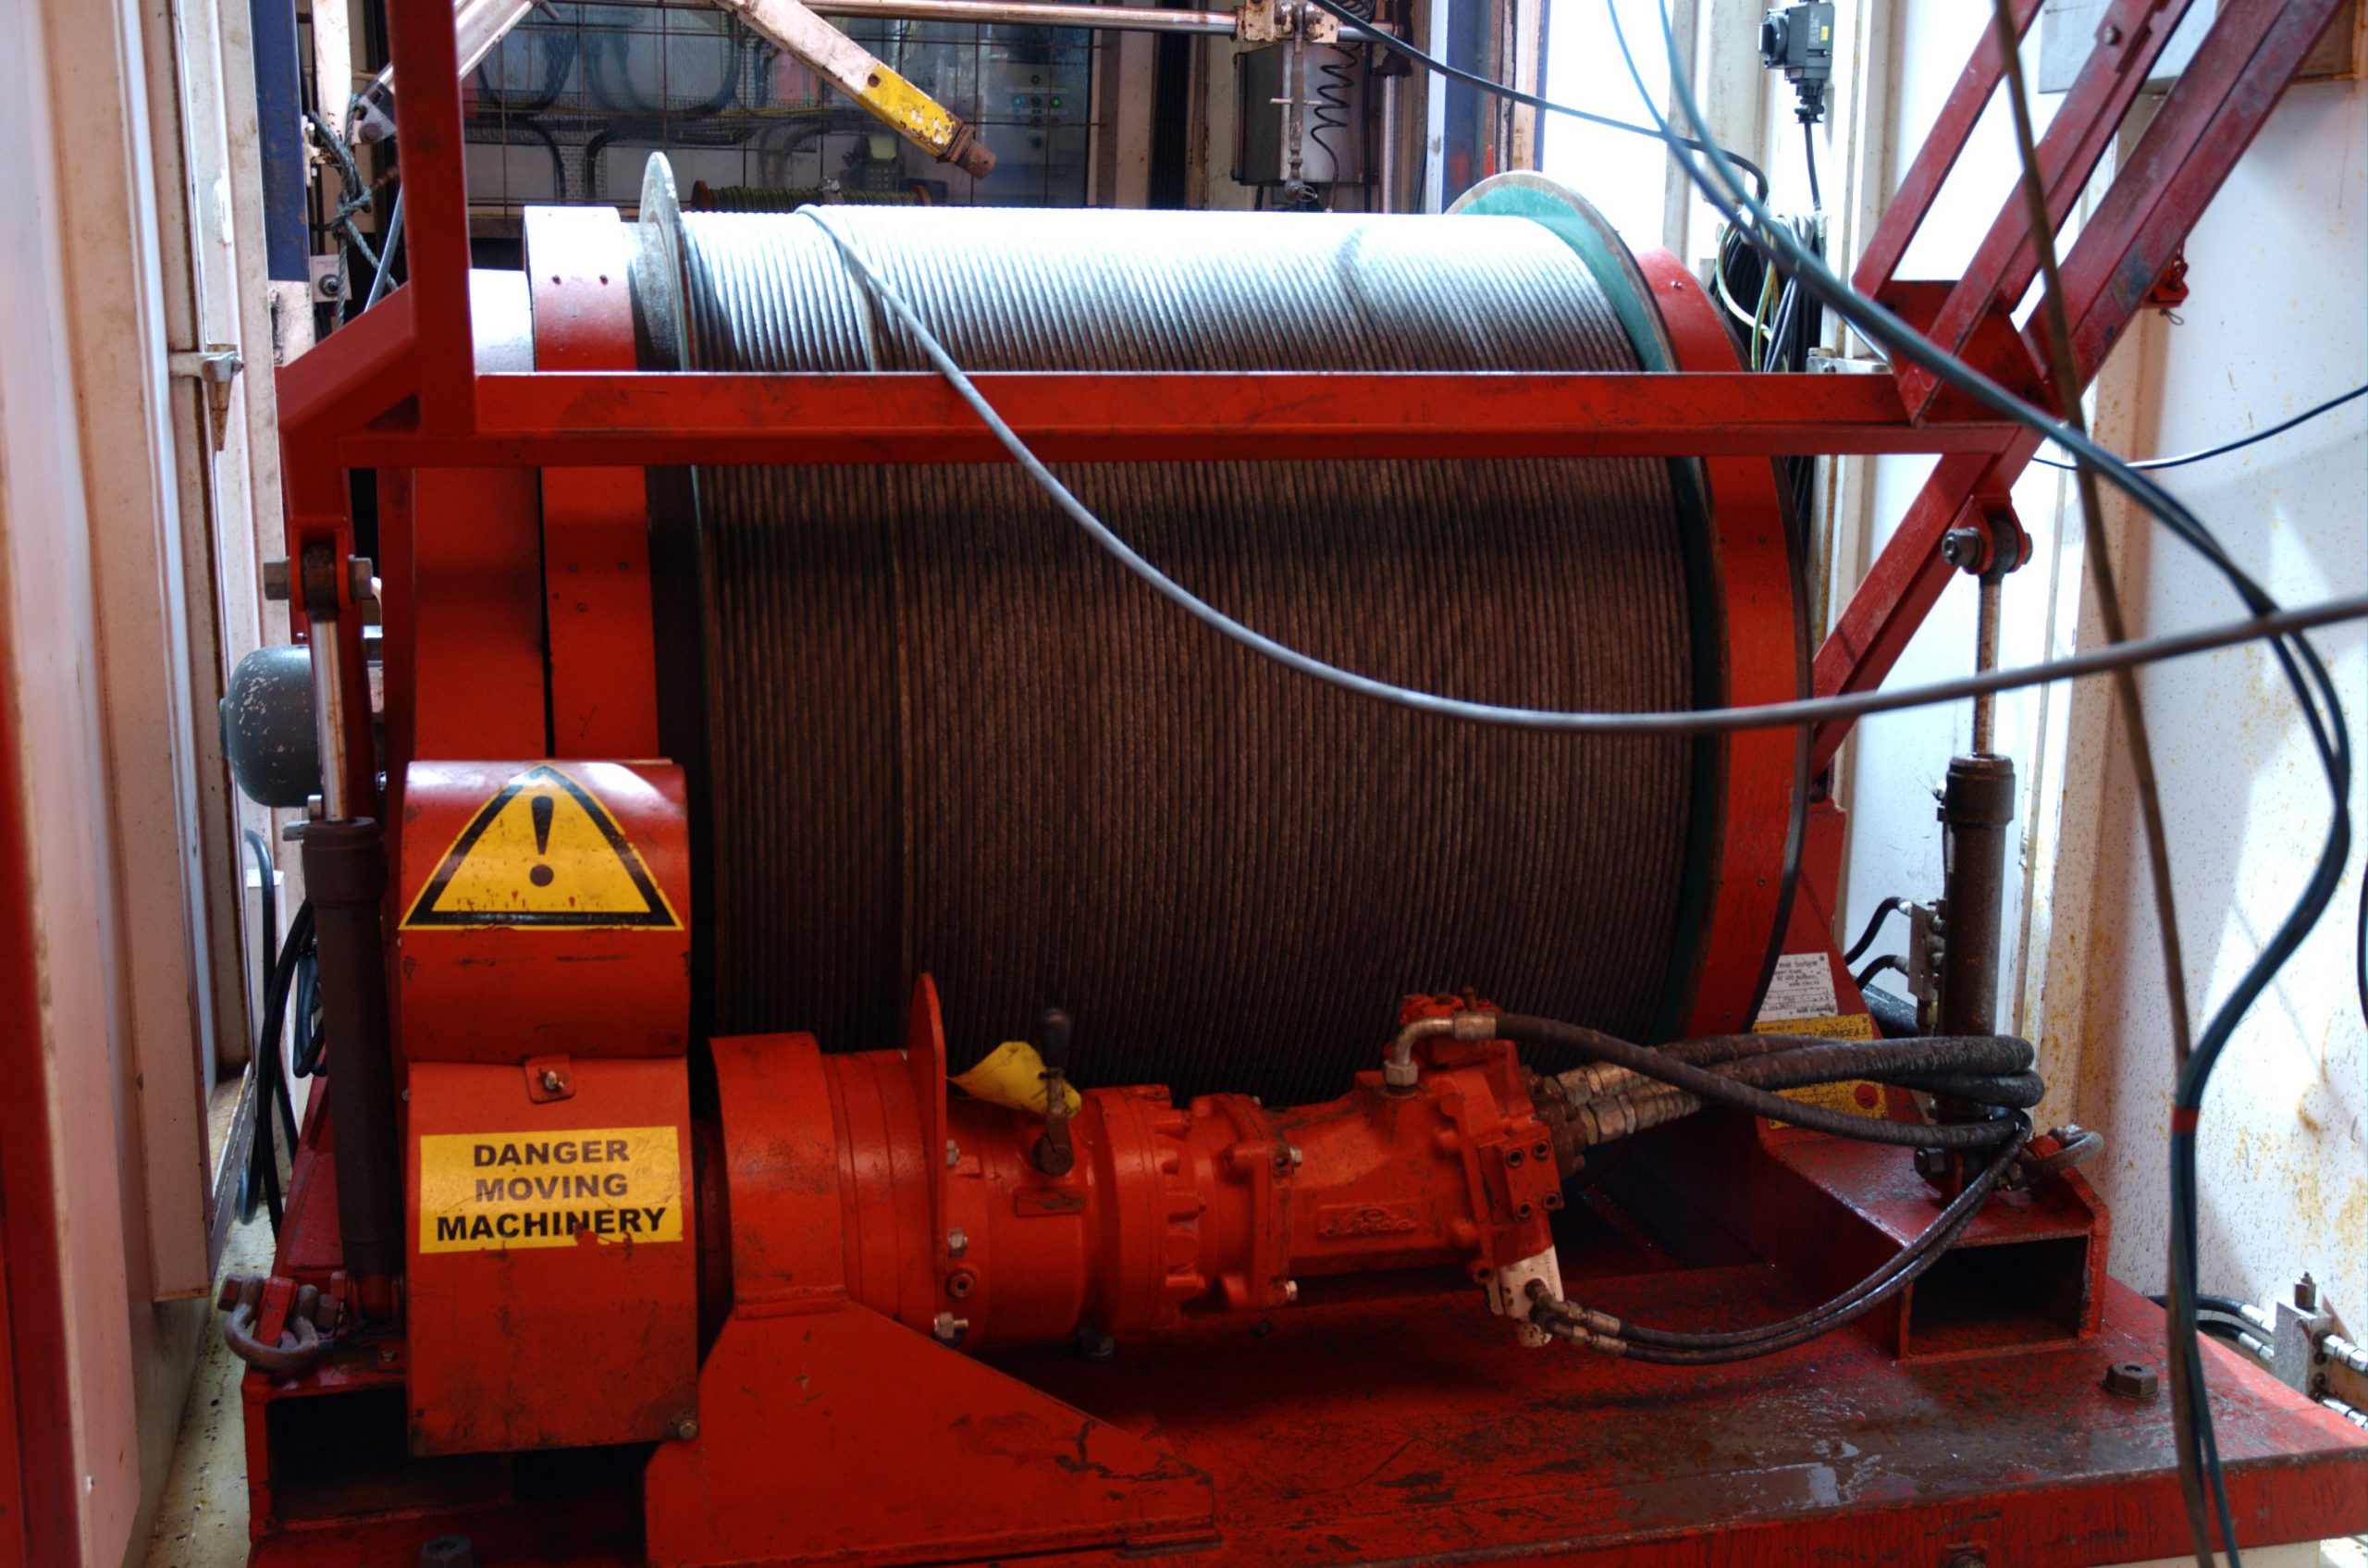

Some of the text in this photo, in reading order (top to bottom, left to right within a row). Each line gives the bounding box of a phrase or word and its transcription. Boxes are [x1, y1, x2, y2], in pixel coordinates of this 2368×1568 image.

[474, 1140, 630, 1167] DANGER
[475, 1173, 628, 1203] MOVING
[437, 1207, 667, 1241] MACHINERY
